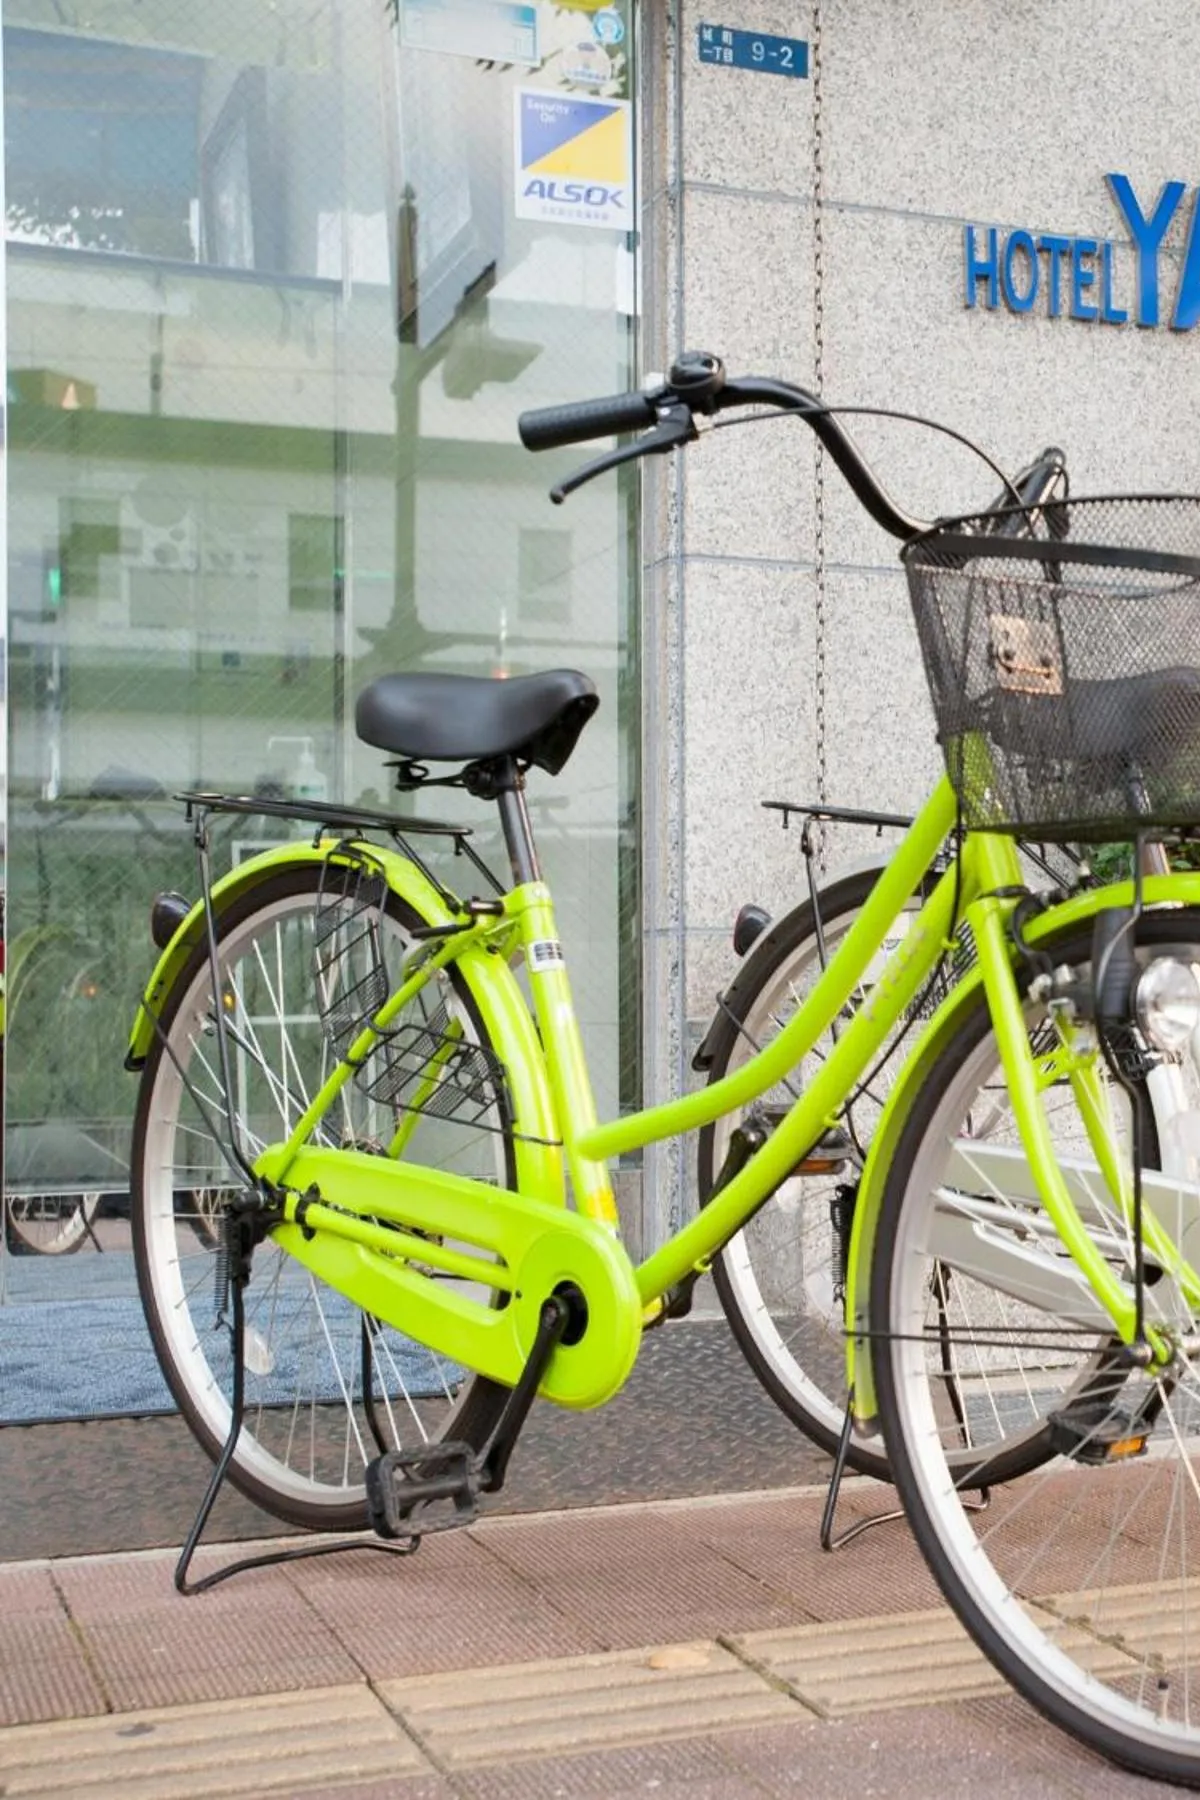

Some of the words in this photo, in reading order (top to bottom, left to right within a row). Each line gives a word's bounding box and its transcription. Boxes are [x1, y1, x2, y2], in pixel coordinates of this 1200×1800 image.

[751, 40, 794, 69] 9-2
[525, 97, 570, 115] Security
[523, 179, 627, 209] ALSOK
[963, 224, 1128, 324] HOTEL
